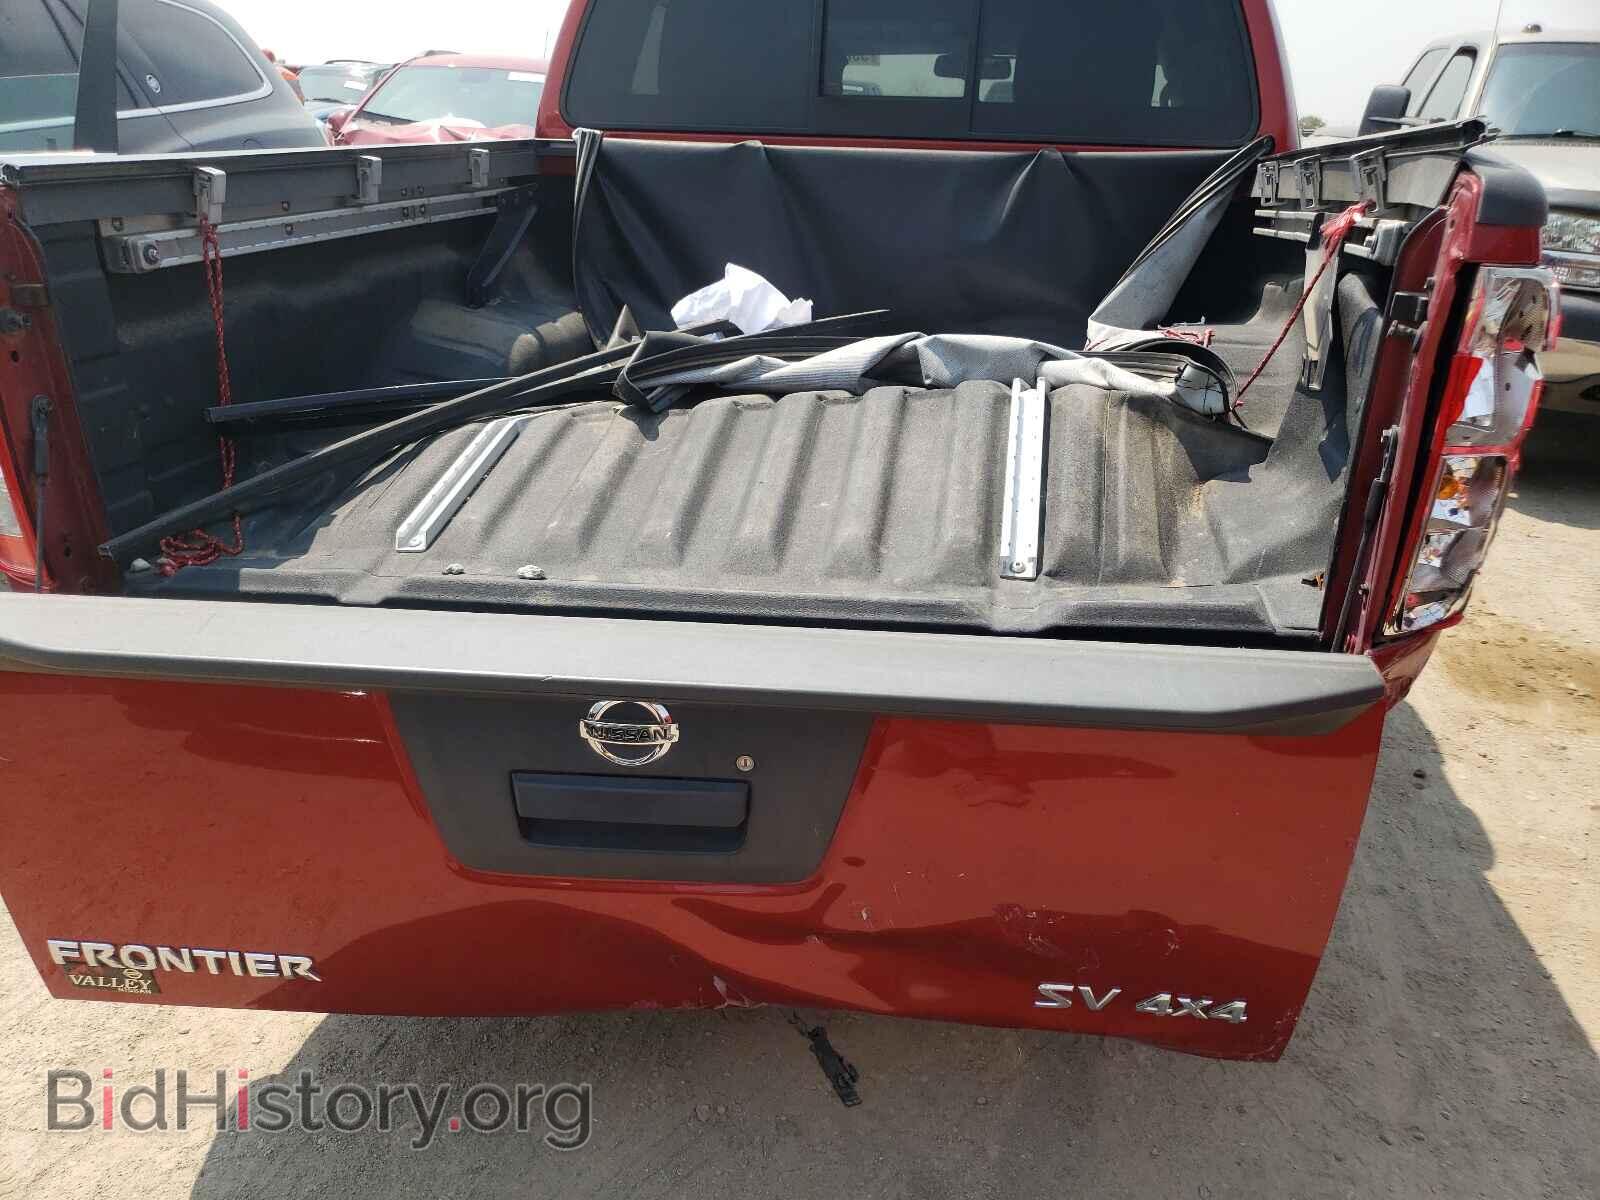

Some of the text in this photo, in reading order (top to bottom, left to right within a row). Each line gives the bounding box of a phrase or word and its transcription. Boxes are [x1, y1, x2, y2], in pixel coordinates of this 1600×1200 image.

[589, 726, 668, 741] NISSAN
[47, 939, 322, 982] FRONTIER
[69, 974, 152, 991] VALLEY
[1035, 983, 1122, 1010] SV
